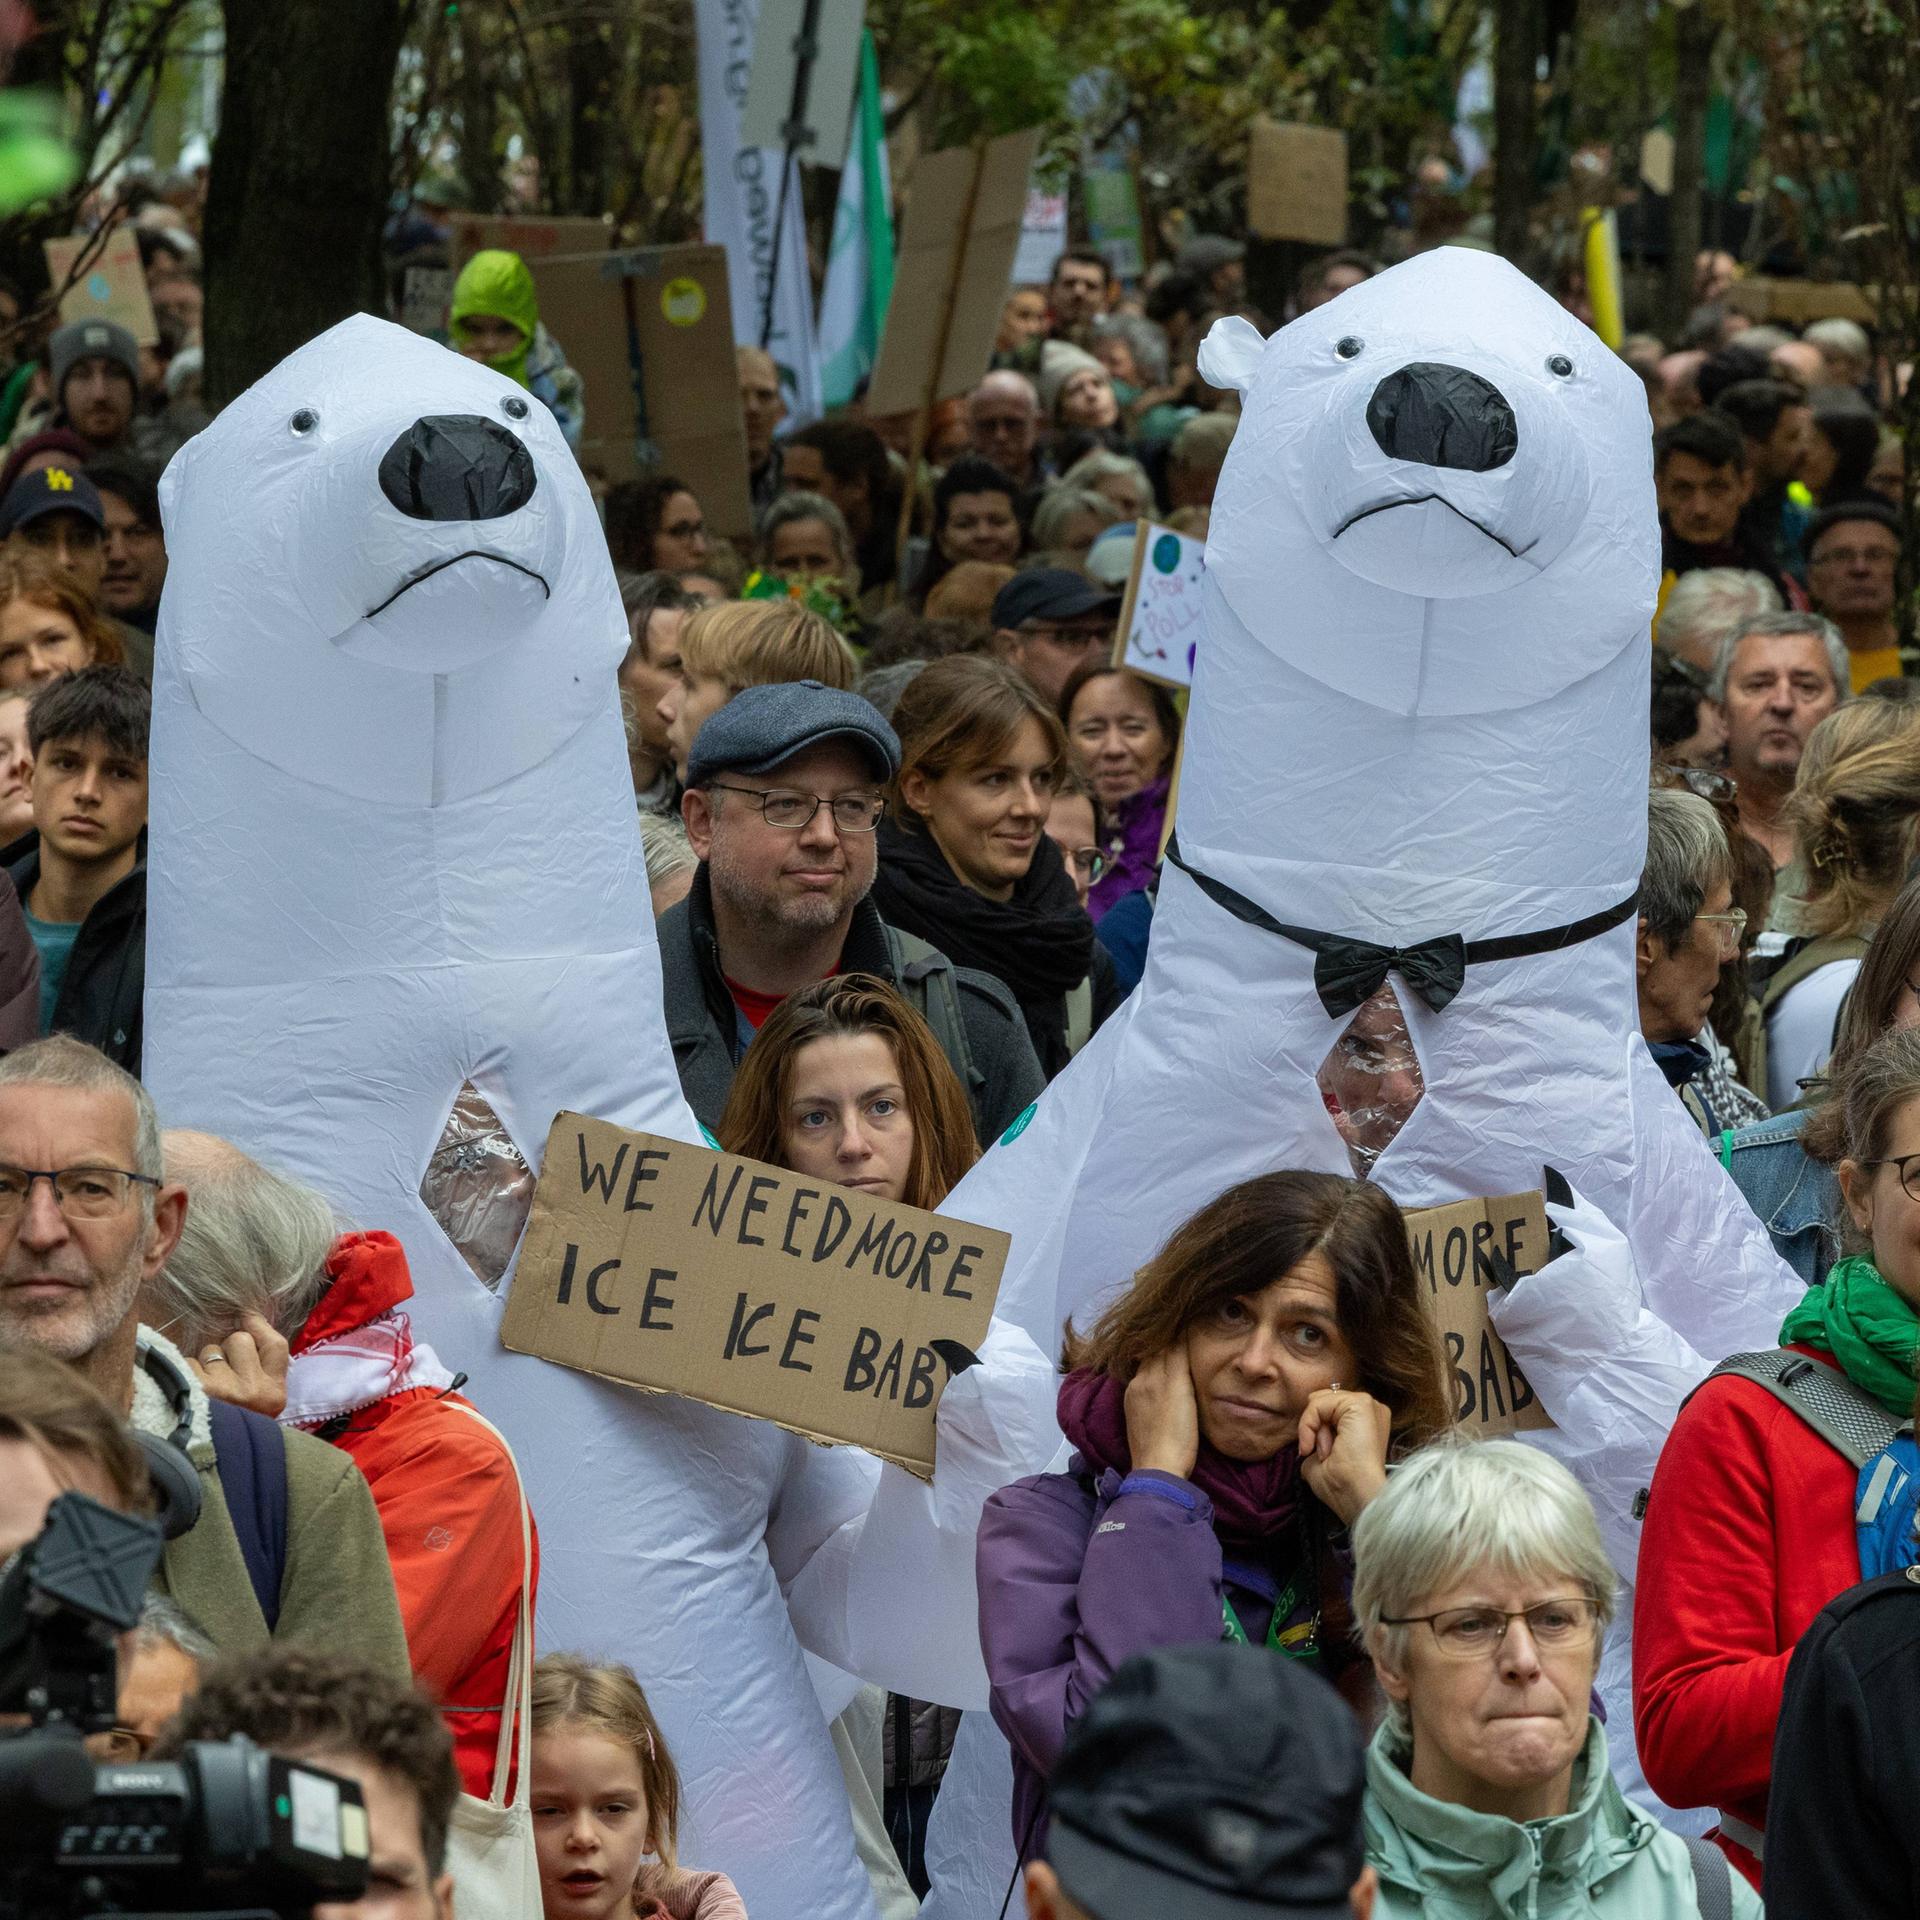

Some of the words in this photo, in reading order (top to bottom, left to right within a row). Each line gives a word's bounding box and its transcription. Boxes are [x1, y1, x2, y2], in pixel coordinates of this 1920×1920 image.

[577, 1133, 670, 1212] WE
[1412, 1217, 1533, 1294] MORE
[556, 1243, 678, 1331] ICE
[723, 1293, 821, 1373] ICE
[844, 1327, 951, 1425] BAB
